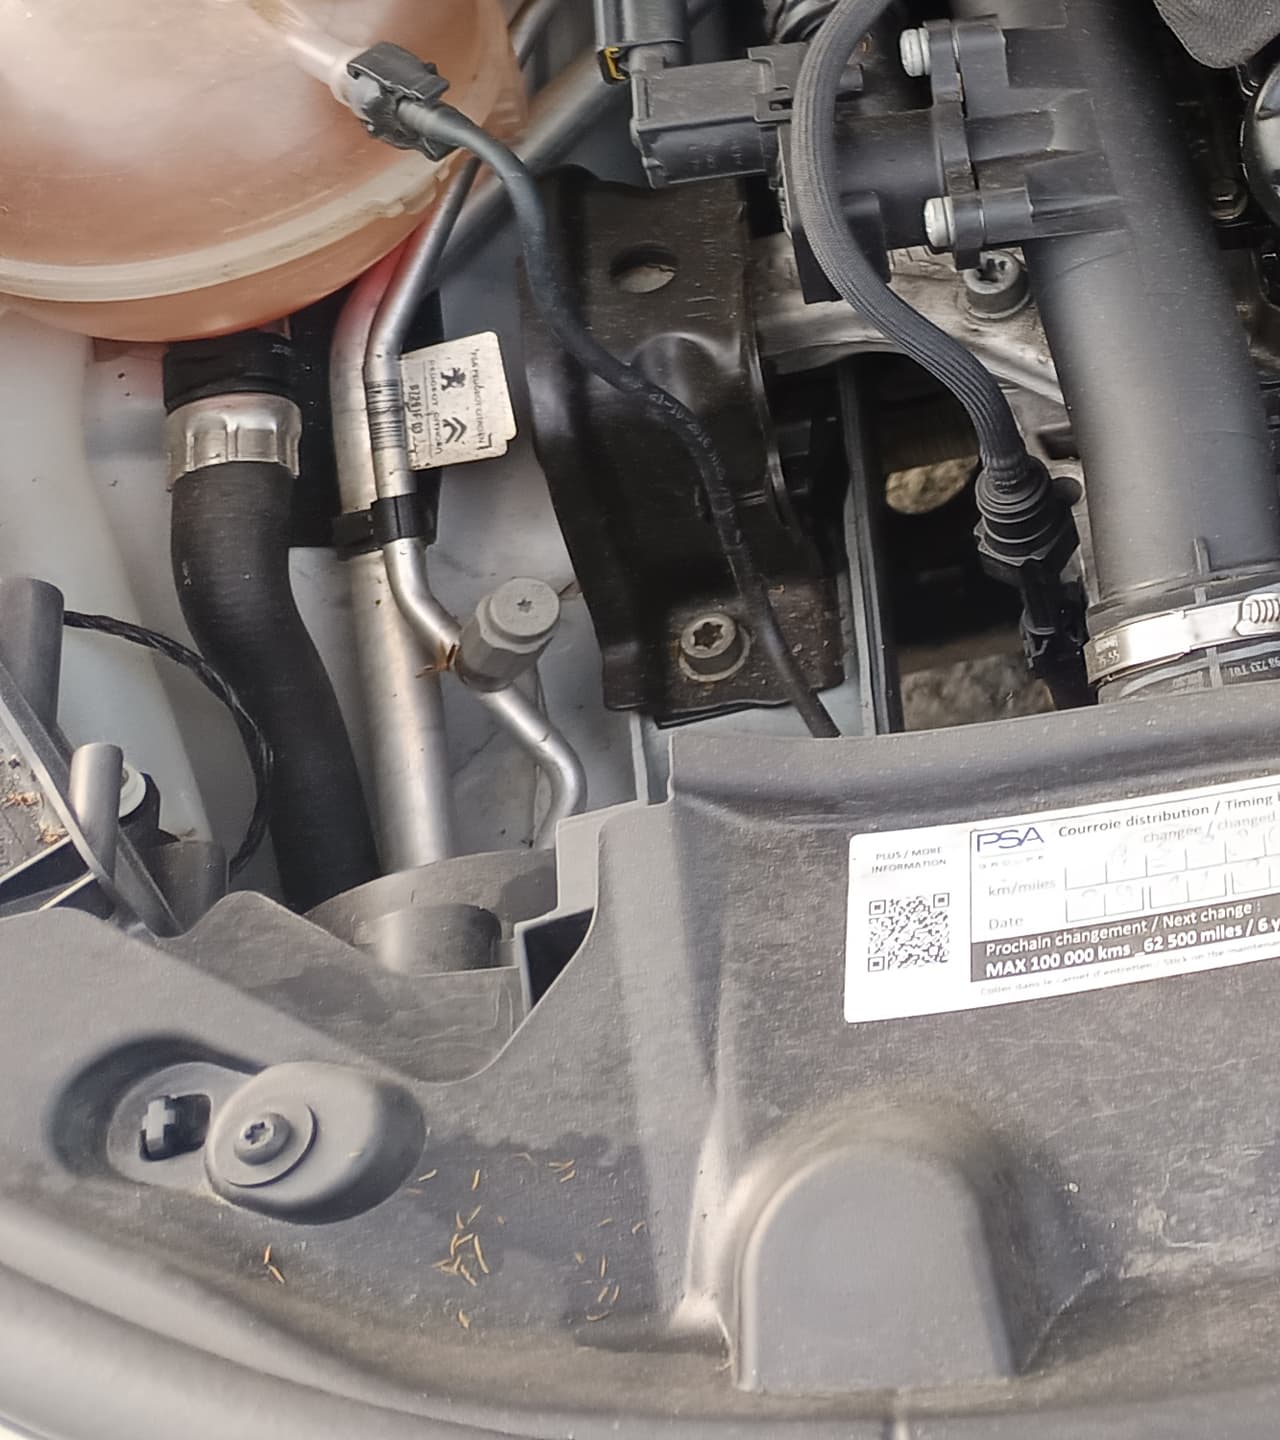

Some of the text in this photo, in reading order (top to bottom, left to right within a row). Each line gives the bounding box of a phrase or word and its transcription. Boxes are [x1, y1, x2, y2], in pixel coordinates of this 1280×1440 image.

[1058, 822, 1121, 839] Courroie
[1125, 805, 1210, 829] distribution
[1225, 795, 1274, 814] Timing
[976, 827, 1044, 852] PSA
[871, 859, 947, 875] INFORMATION
[985, 936, 1051, 958] Prochain
[1054, 919, 1149, 947] changement
[1162, 911, 1198, 929] Next
[1199, 903, 1253, 925] change
[988, 916, 1025, 931] Date
[985, 958, 1027, 979] MAX
[1029, 954, 1062, 971] 100
[1063, 949, 1096, 967] 000
[1097, 943, 1132, 962] kms
[1166, 931, 1198, 950] 500
[1200, 923, 1243, 943] miles
[1257, 920, 1269, 932] 6
